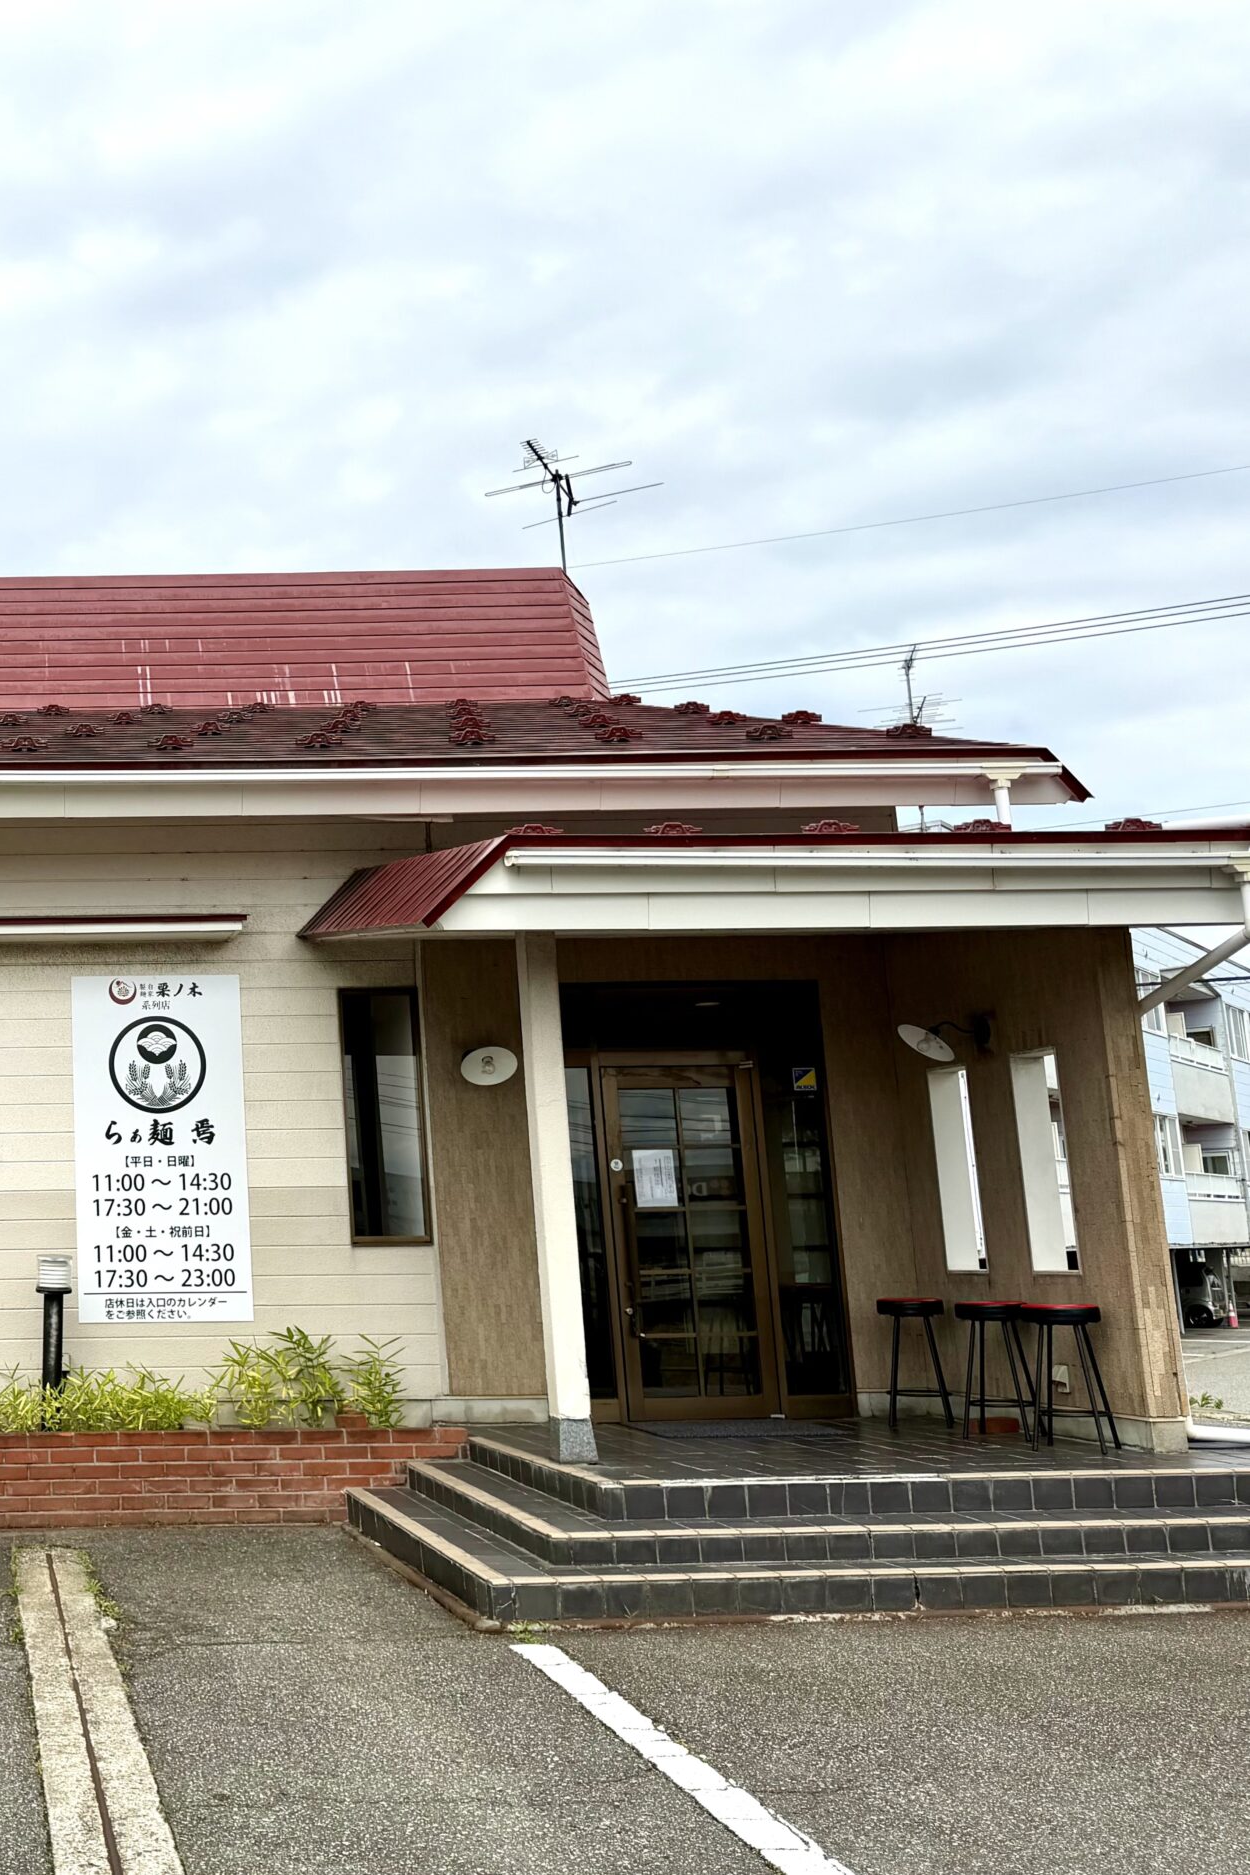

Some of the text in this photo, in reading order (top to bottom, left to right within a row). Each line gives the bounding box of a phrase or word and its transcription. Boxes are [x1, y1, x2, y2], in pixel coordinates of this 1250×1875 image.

[155, 982, 203, 998] 栗ノ木
[141, 1000, 171, 1010] 系列店
[125, 1155, 195, 1168] 【平日・日曜】
[116, 1225, 210, 1238] 【金・土・祝前日】
[104, 1297, 228, 1309] 店休日は入口のカレンダー
[105, 1309, 192, 1320] をご参照ください。
